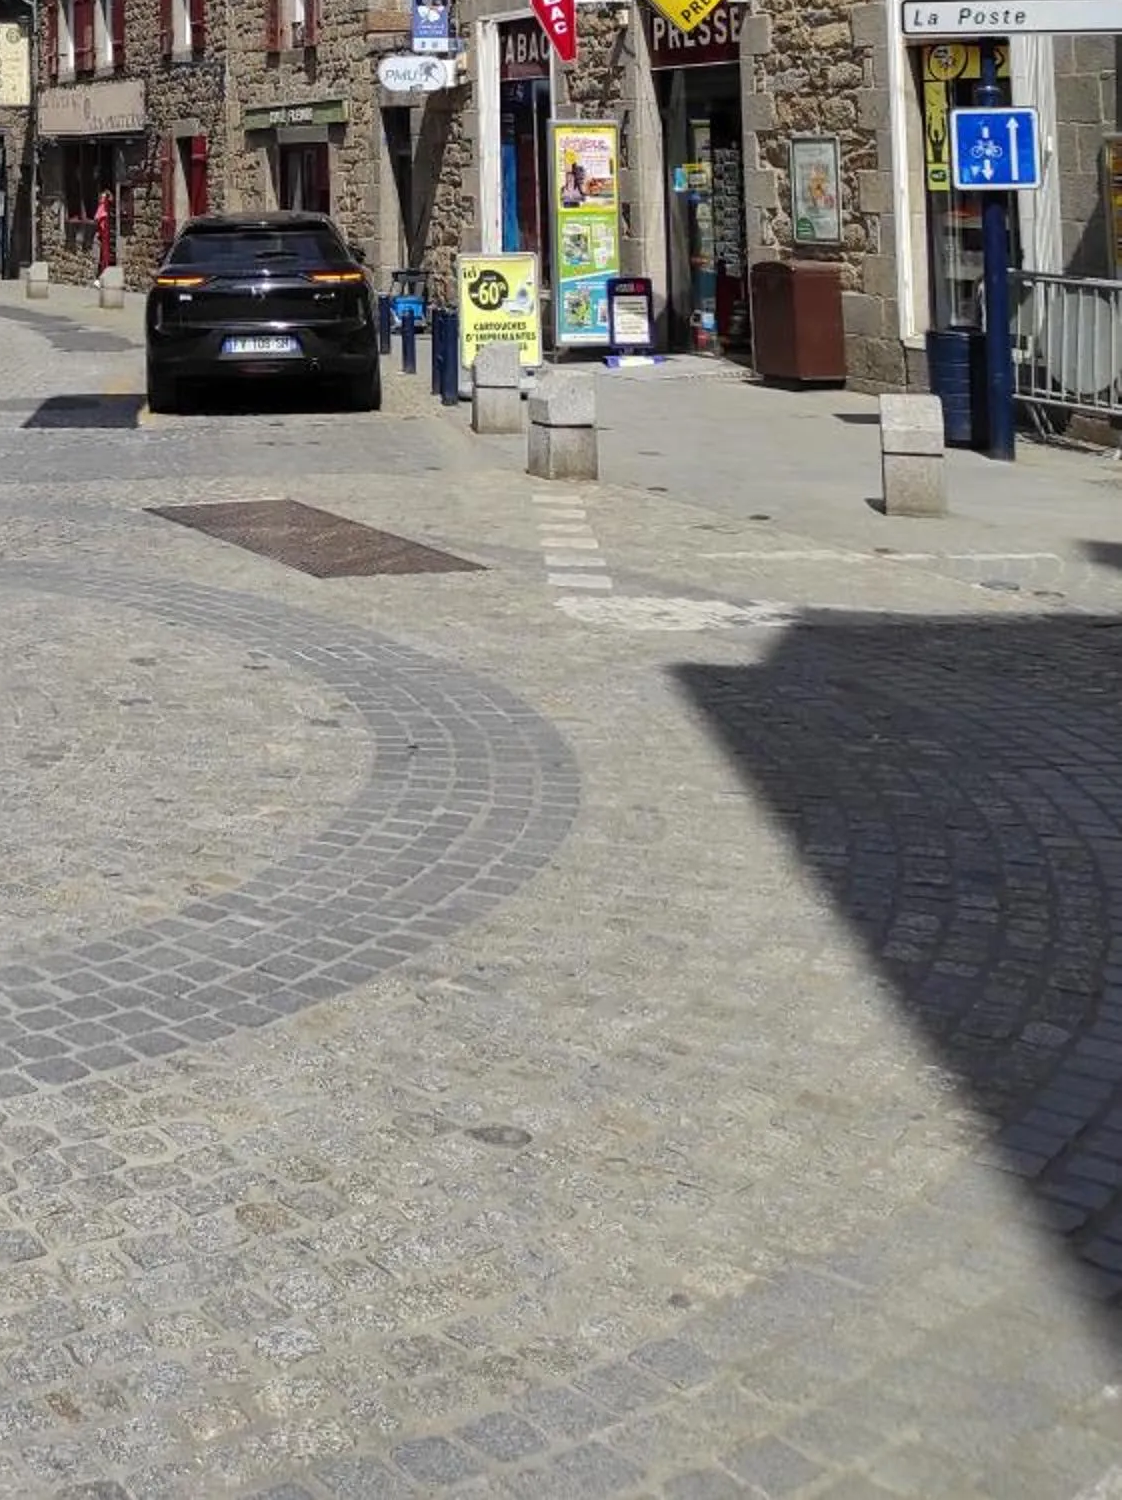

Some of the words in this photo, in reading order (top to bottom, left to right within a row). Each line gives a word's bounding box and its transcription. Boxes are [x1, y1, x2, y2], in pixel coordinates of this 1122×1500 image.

[913, 9, 939, 26] La
[958, 7, 1026, 25] Poste
[385, 68, 419, 82] PMU
[473, 321, 527, 331] CARTOUCHES
[466, 332, 536, 342] D'IMPRIMANTES
